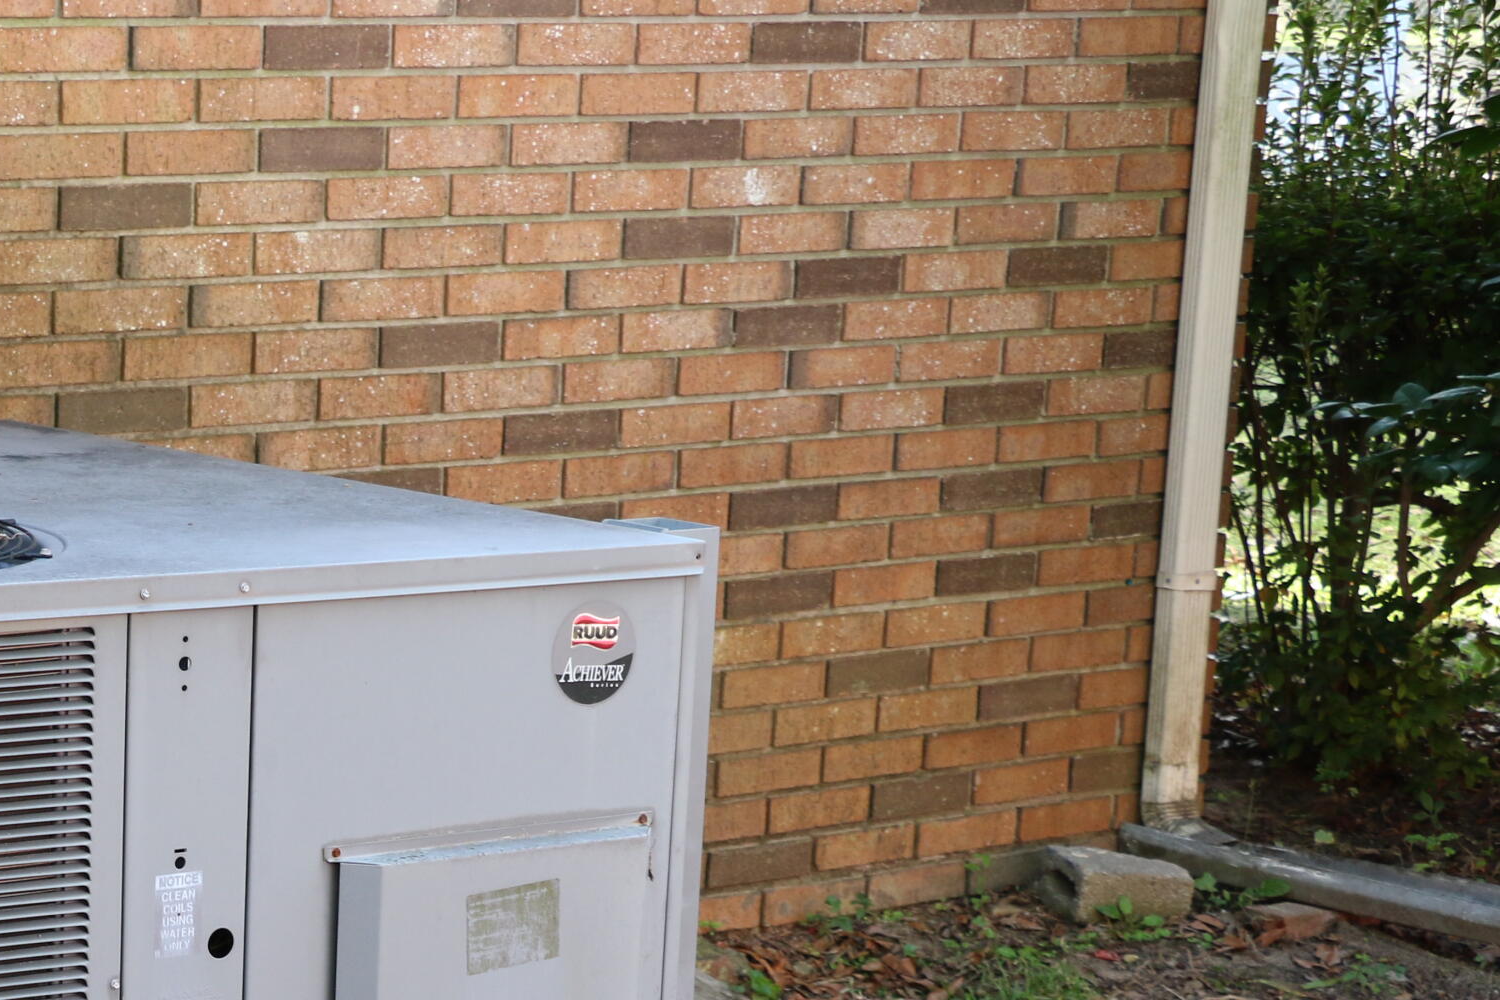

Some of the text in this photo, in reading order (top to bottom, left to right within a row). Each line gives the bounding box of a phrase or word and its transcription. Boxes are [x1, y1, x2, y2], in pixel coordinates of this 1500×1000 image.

[572, 625, 618, 640] RUUD
[159, 872, 200, 887] NOTICE
[161, 889, 196, 902] CLEAN
[163, 902, 194, 914] COILS
[162, 914, 194, 927] USING
